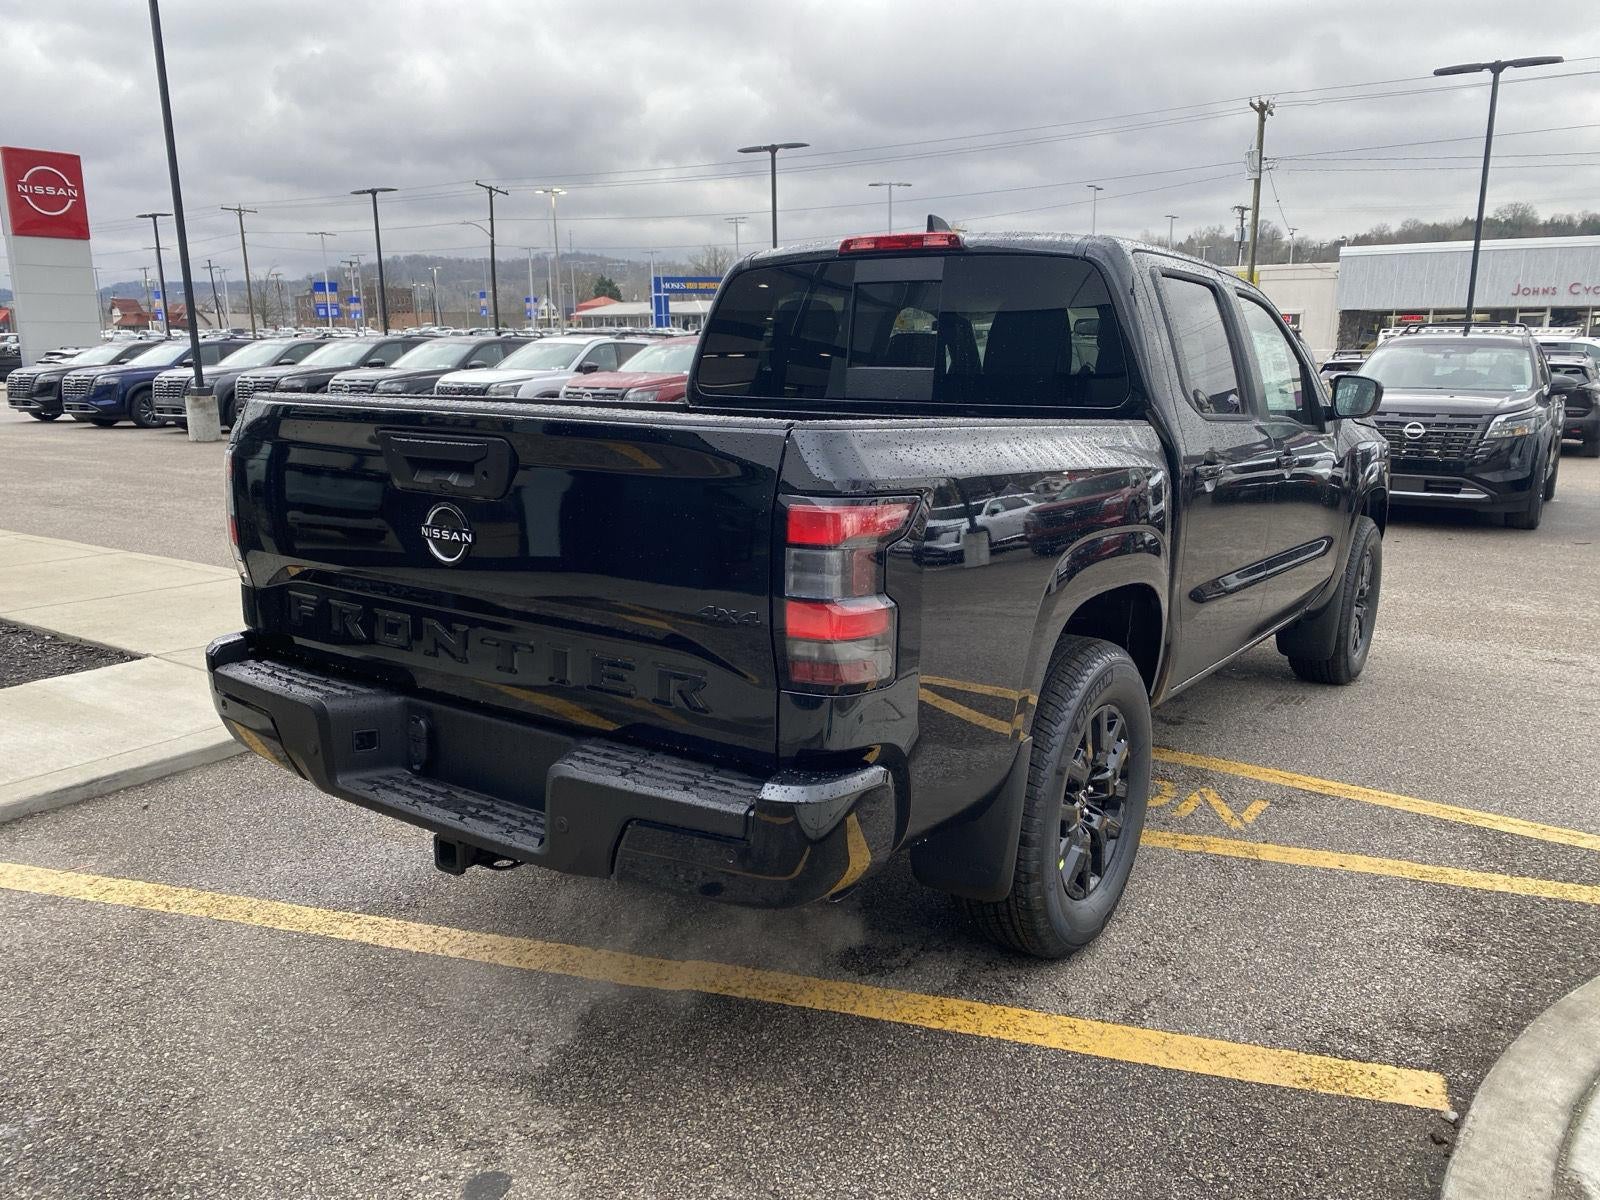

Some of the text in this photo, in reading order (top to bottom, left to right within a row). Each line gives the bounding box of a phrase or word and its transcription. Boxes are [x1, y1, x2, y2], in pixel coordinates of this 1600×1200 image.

[17, 184, 78, 197] NISSAN
[421, 526, 472, 543] NISSAN
[287, 590, 710, 714] FRONTIER
